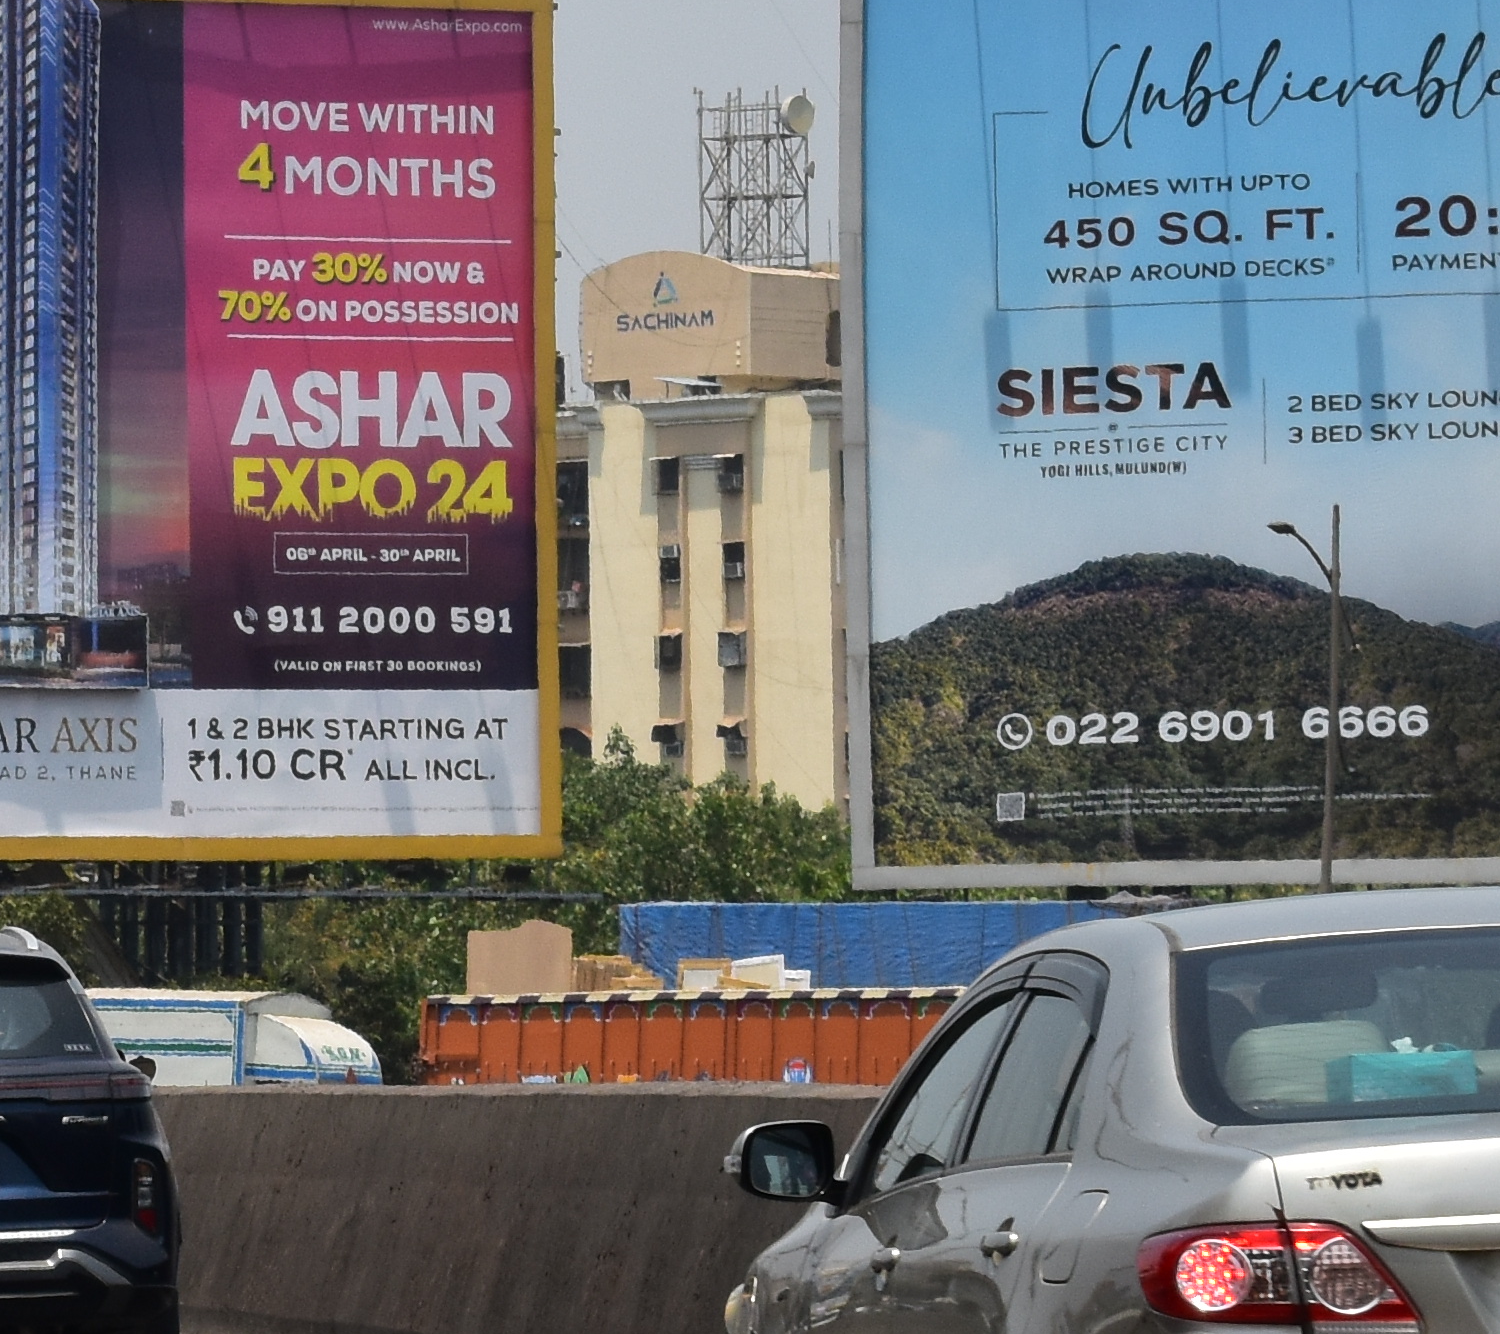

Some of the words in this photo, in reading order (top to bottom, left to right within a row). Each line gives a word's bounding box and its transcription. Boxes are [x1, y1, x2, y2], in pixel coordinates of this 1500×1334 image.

[372, 18, 523, 35] www.AsharExpo.com
[240, 99, 350, 132] MOVE
[358, 102, 494, 135] WITHIN
[238, 142, 276, 191] 4
[284, 155, 496, 199] MONTHS
[1068, 177, 1160, 199] HOMES
[1168, 175, 1233, 196] WITH
[1241, 172, 1311, 193] UPTO
[1043, 216, 1136, 249] 450
[1157, 211, 1243, 246] SQ.
[1266, 207, 1336, 241] FT.
[253, 258, 305, 281] PAY
[312, 252, 389, 284] 30%
[393, 261, 461, 284] NOW
[466, 262, 485, 284] &
[1047, 265, 1123, 285] WRAP
[1130, 262, 1236, 283] AROUND
[218, 289, 291, 323] 70%
[296, 299, 337, 322] ON
[345, 300, 519, 324] POSSESSION
[616, 309, 714, 333] SACHINAM
[996, 361, 1232, 418] SIESTA
[1287, 395, 1303, 414] 2
[1311, 393, 1362, 412] BED
[1370, 392, 1419, 410] SKY
[230, 369, 513, 449] ASHAR
[999, 442, 1042, 459] THE
[1054, 436, 1165, 456] PRESTIGE
[1176, 435, 1229, 452] CITY
[1287, 426, 1303, 445] 3
[1311, 425, 1362, 443] BED
[1370, 423, 1420, 441] SKY
[1041, 465, 1070, 479] YOGI
[1075, 463, 1114, 478] HILLS,
[1115, 461, 1187, 476] MULUND(W)
[233, 456, 416, 522] EXPO
[427, 458, 513, 524] 24
[320, 548, 368, 562] APRIL
[412, 548, 461, 563] APRIL
[266, 605, 325, 634] 911
[339, 606, 436, 634] 2000
[450, 606, 513, 634] 591
[274, 658, 319, 674] (VALID
[323, 659, 341, 673] ON
[346, 659, 383, 673] FIRST
[386, 659, 404, 673] 30
[407, 659, 482, 674] BOOKINGS)
[50, 716, 138, 754] AXIS
[187, 717, 198, 740] 1
[206, 718, 226, 740] &
[233, 718, 249, 740] 2
[257, 718, 315, 740] BHK
[324, 718, 465, 741] STARTING
[474, 717, 509, 740] AT
[1045, 712, 1139, 746] 022
[1158, 710, 1275, 743] 6901
[1301, 705, 1430, 739] 6666
[37, 765, 56, 781] 2,
[62, 765, 138, 781] THANE
[188, 748, 276, 782] ₹1.10
[364, 759, 417, 781] ALL
[425, 759, 496, 781] INCL.
